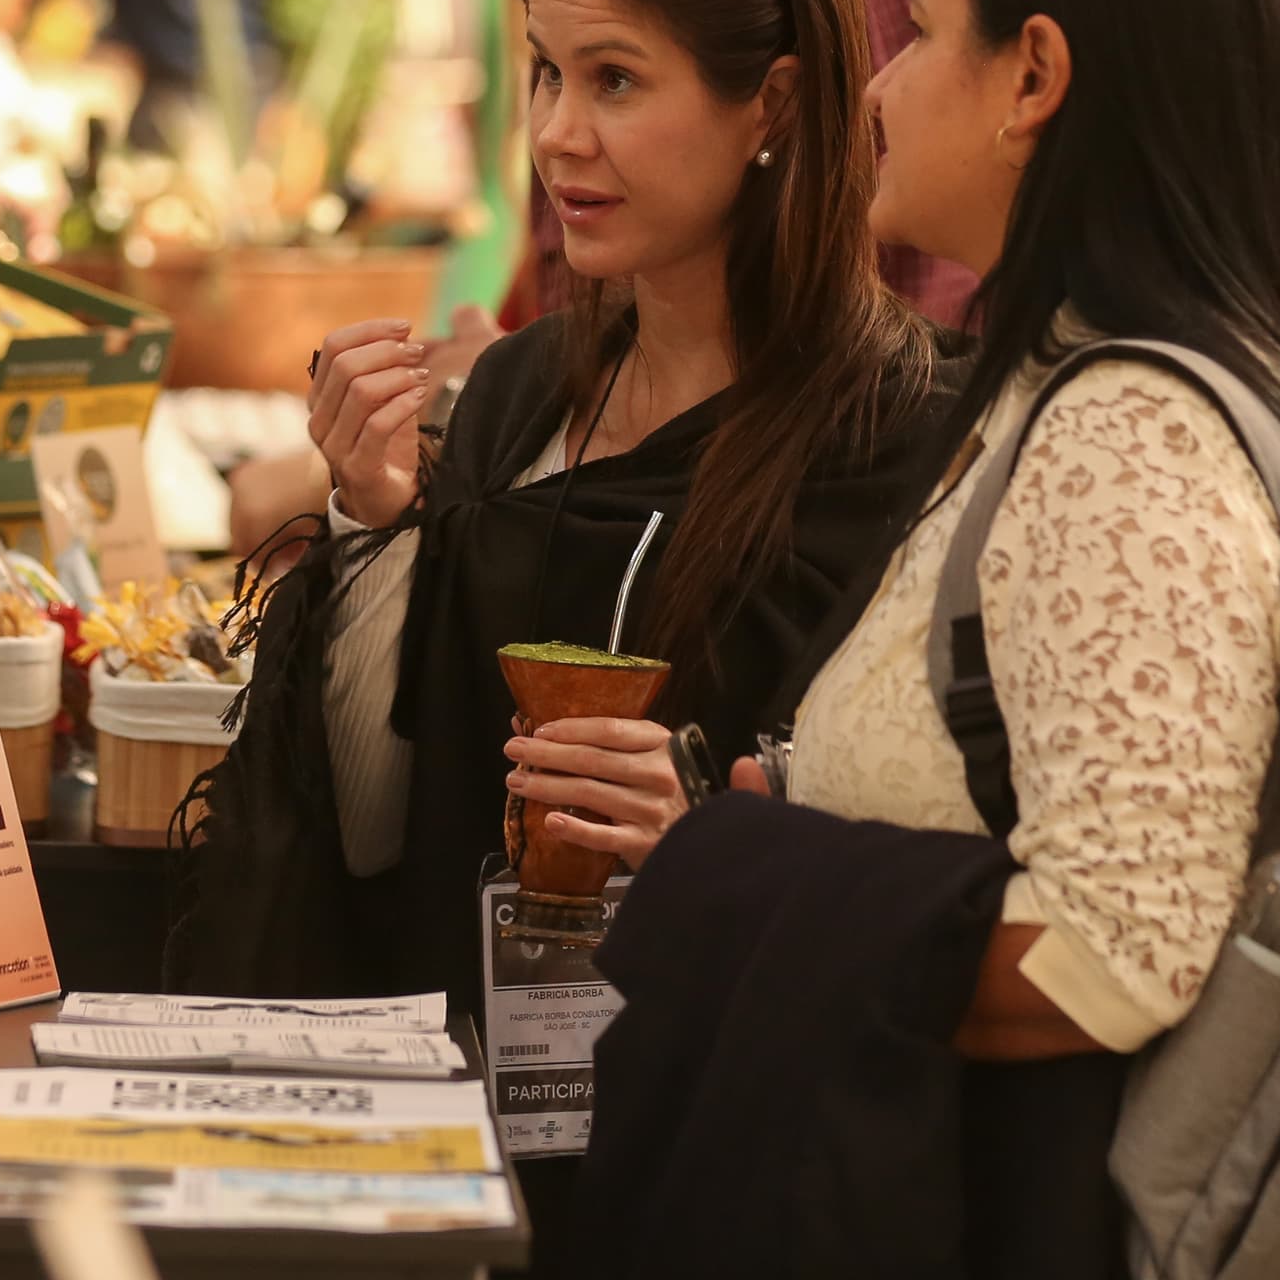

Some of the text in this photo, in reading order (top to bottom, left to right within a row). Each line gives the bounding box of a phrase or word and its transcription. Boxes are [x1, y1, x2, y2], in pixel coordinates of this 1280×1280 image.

[528, 988, 604, 1001] FABRICIA BORBA
[510, 1013, 544, 1022] FABRICIA
[545, 1010, 571, 1020] BORBA
